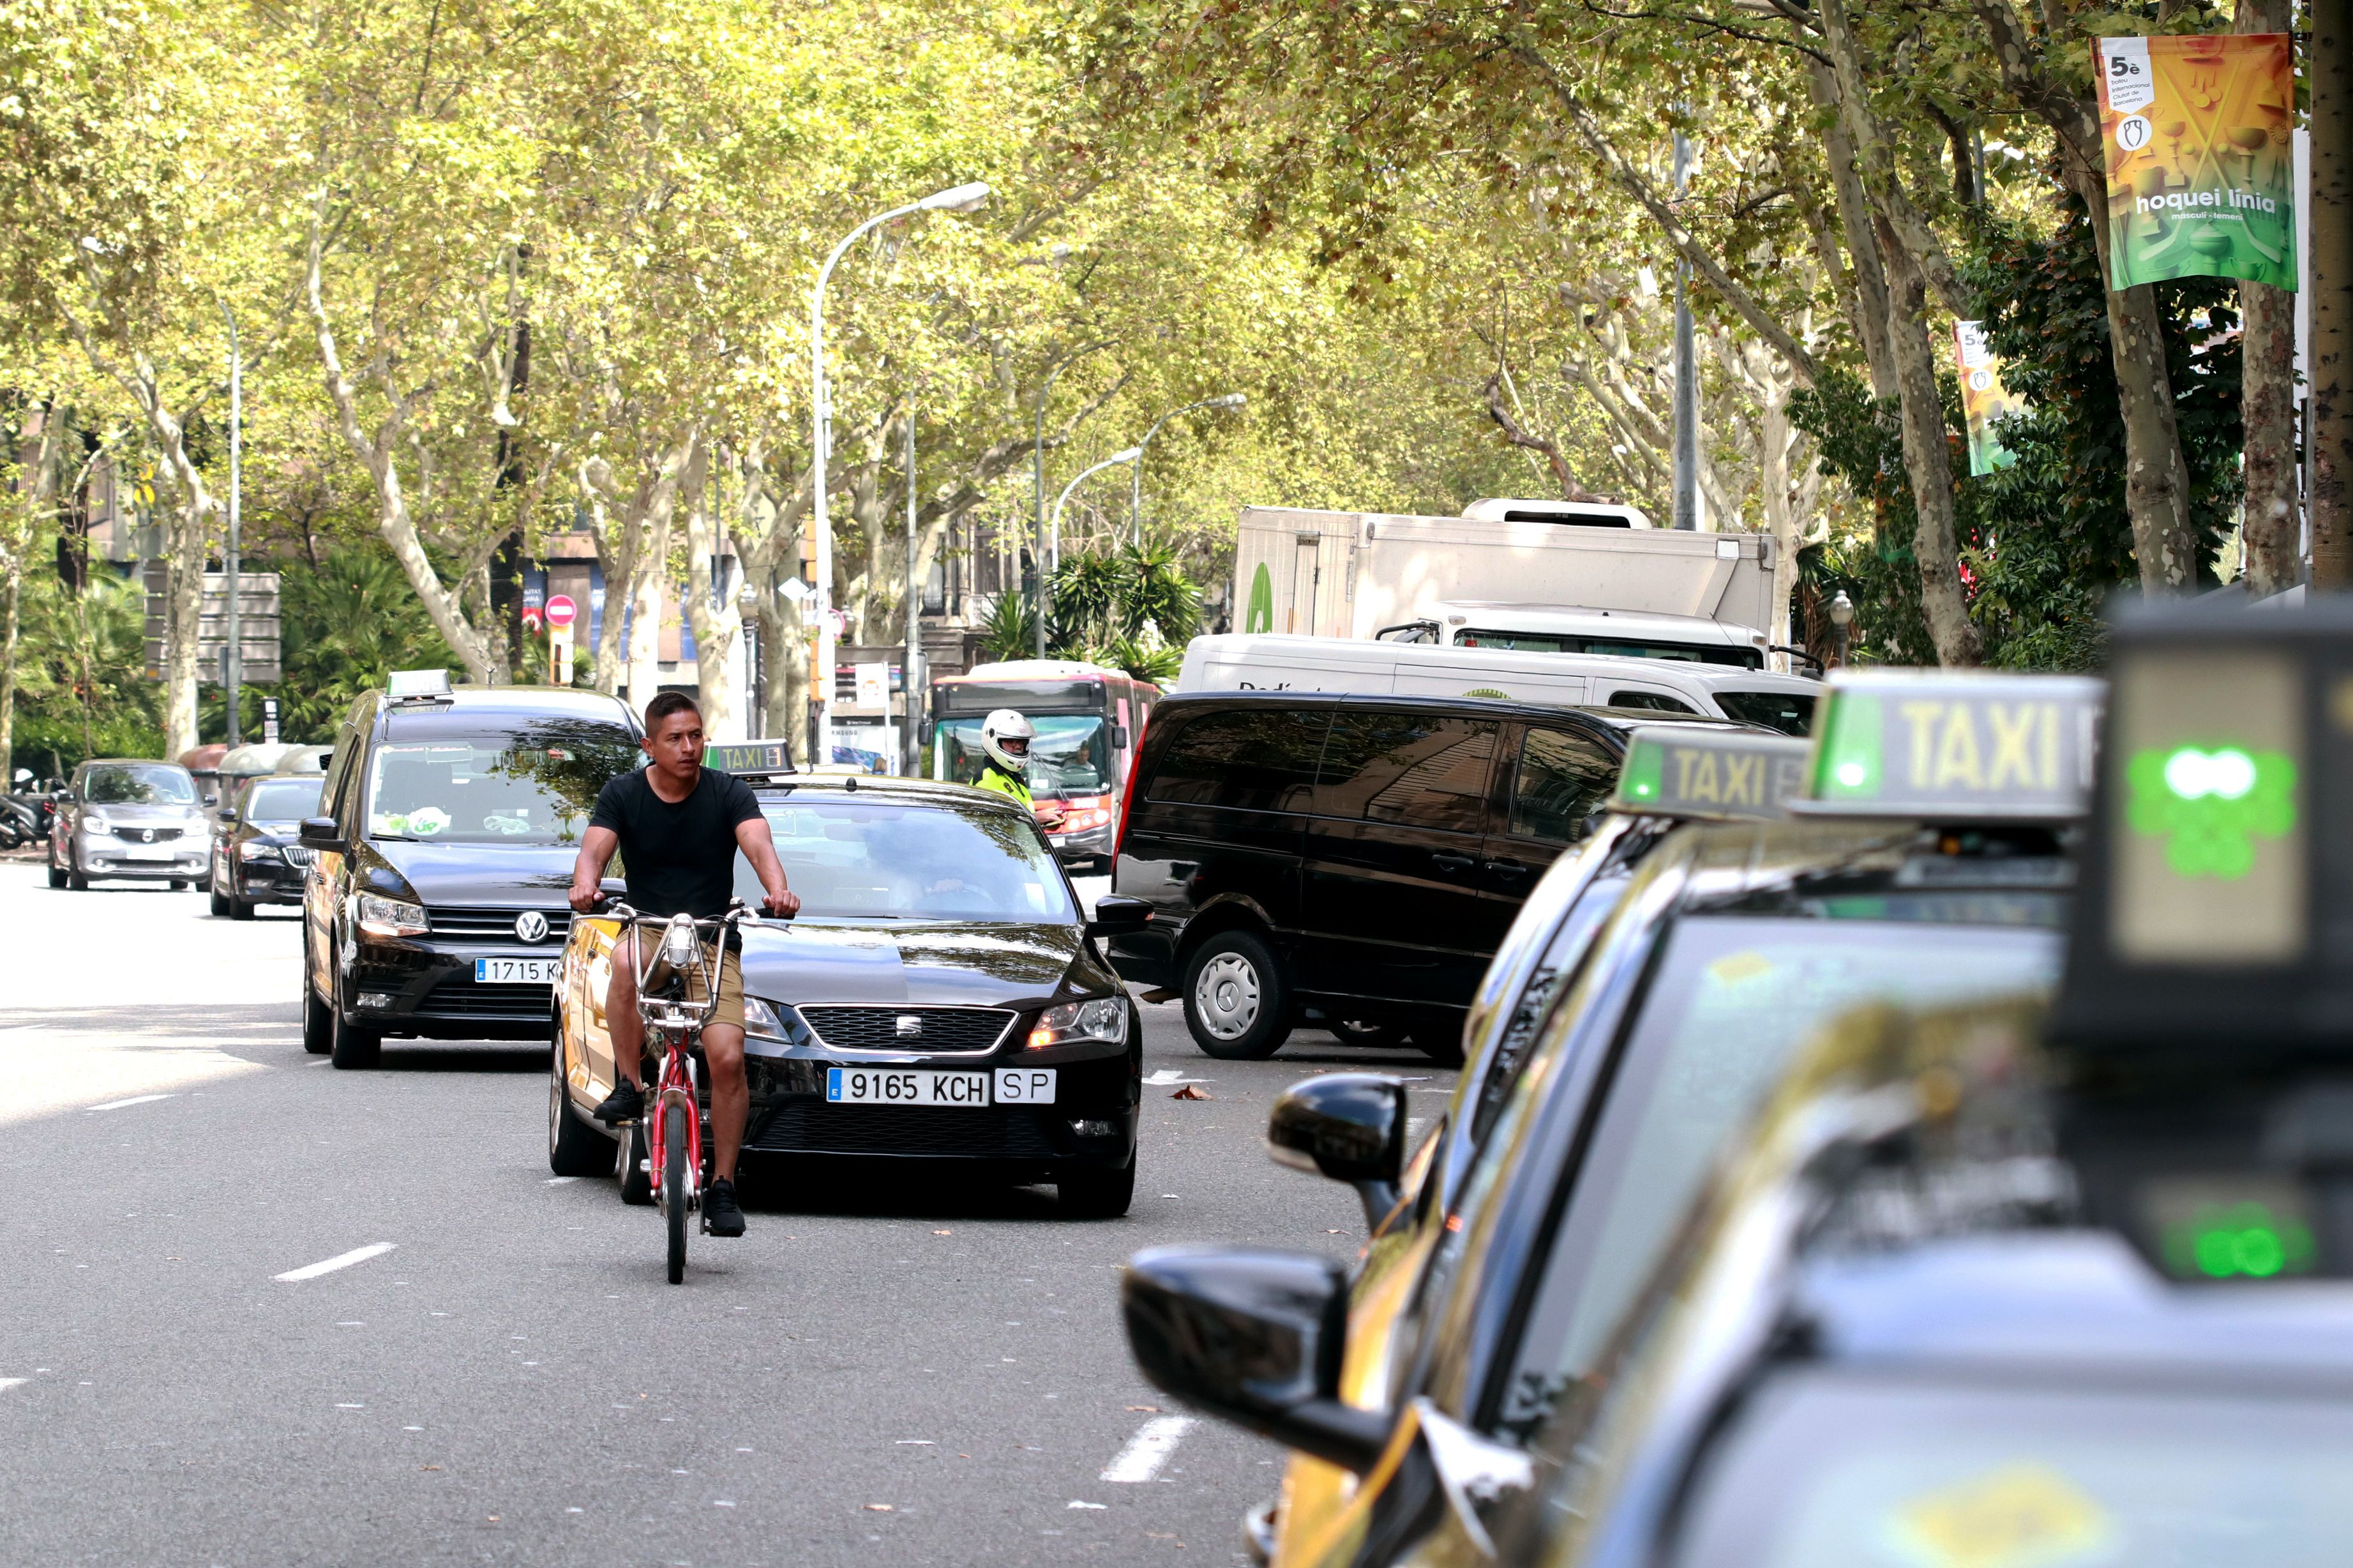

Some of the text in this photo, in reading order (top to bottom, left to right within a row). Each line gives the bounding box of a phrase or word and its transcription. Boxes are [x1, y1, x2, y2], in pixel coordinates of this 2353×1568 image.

[2111, 56, 2140, 77] 5è
[2112, 83, 2151, 93] Internacional
[2113, 92, 2130, 100] Ciutat
[2113, 97, 2143, 107] Barcelona
[2135, 188, 2276, 214] hoquei línia
[2171, 211, 2207, 220] masculí
[1900, 700, 2062, 793] TAXI
[722, 747, 762, 769] TAXI
[1674, 749, 1764, 806] TAXI
[492, 962, 539, 980] 1715
[547, 962, 557, 980] K
[851, 1073, 918, 1100] 9165
[933, 1075, 983, 1103] KCH
